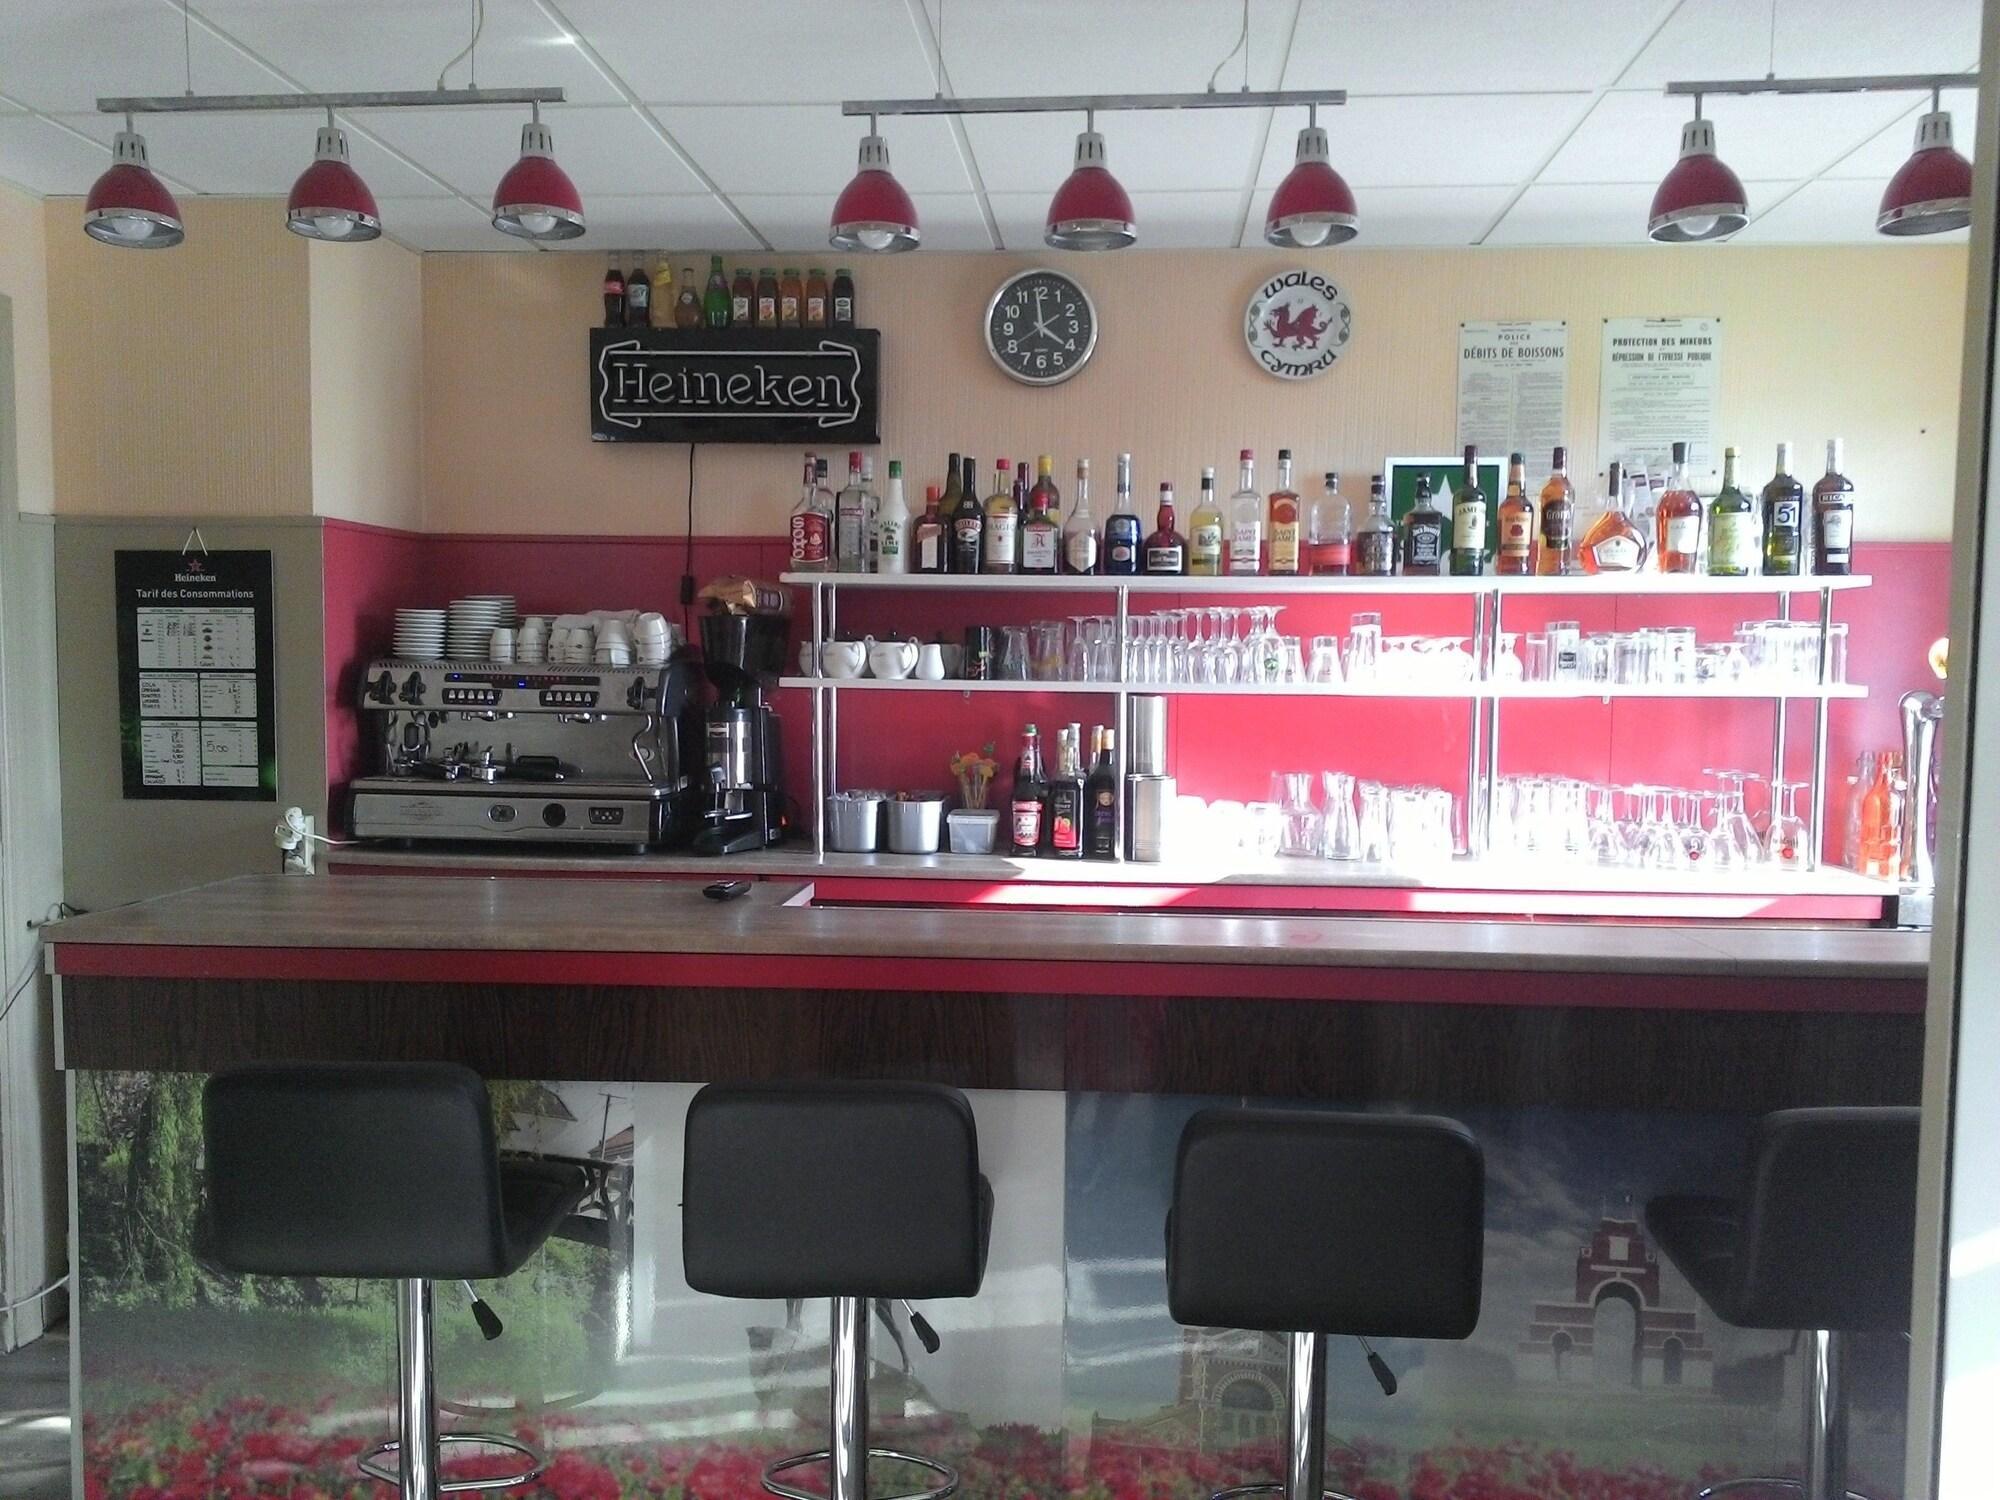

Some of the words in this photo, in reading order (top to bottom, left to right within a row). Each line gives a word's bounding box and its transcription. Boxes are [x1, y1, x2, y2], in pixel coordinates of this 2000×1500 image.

[1017, 291, 1028, 304] 11
[1033, 286, 1048, 300] 12
[1055, 289, 1061, 303] 1
[1005, 305, 1020, 319] 10
[1065, 304, 1076, 317] 2
[1003, 322, 1014, 336] 9
[1068, 320, 1079, 333] 3
[1008, 340, 1018, 354] 8
[1065, 338, 1076, 352] 4
[1612, 337, 1658, 346] PROTECTION
[1661, 337, 1675, 346] DES
[1679, 337, 1712, 346] MINEURS
[1021, 352, 1031, 366] 7
[1053, 352, 1063, 365] 5
[1464, 345, 1497, 359] DÉBITS
[1501, 347, 1513, 358] DE
[1518, 346, 1564, 358] BOISSONS
[1612, 351, 1644, 361] RÉPRESSION
[1648, 352, 1654, 361] DE
[1687, 352, 1712, 361] PUBLIQUE
[1036, 355, 1047, 369] 6
[612, 363, 848, 407] Heineken
[1777, 506, 1796, 523] 51
[792, 516, 806, 559] SOHO
[174, 573, 217, 582] Heineken
[136, 589, 159, 598] Tarif
[161, 589, 178, 598] des
[180, 589, 255, 599] Consommations
